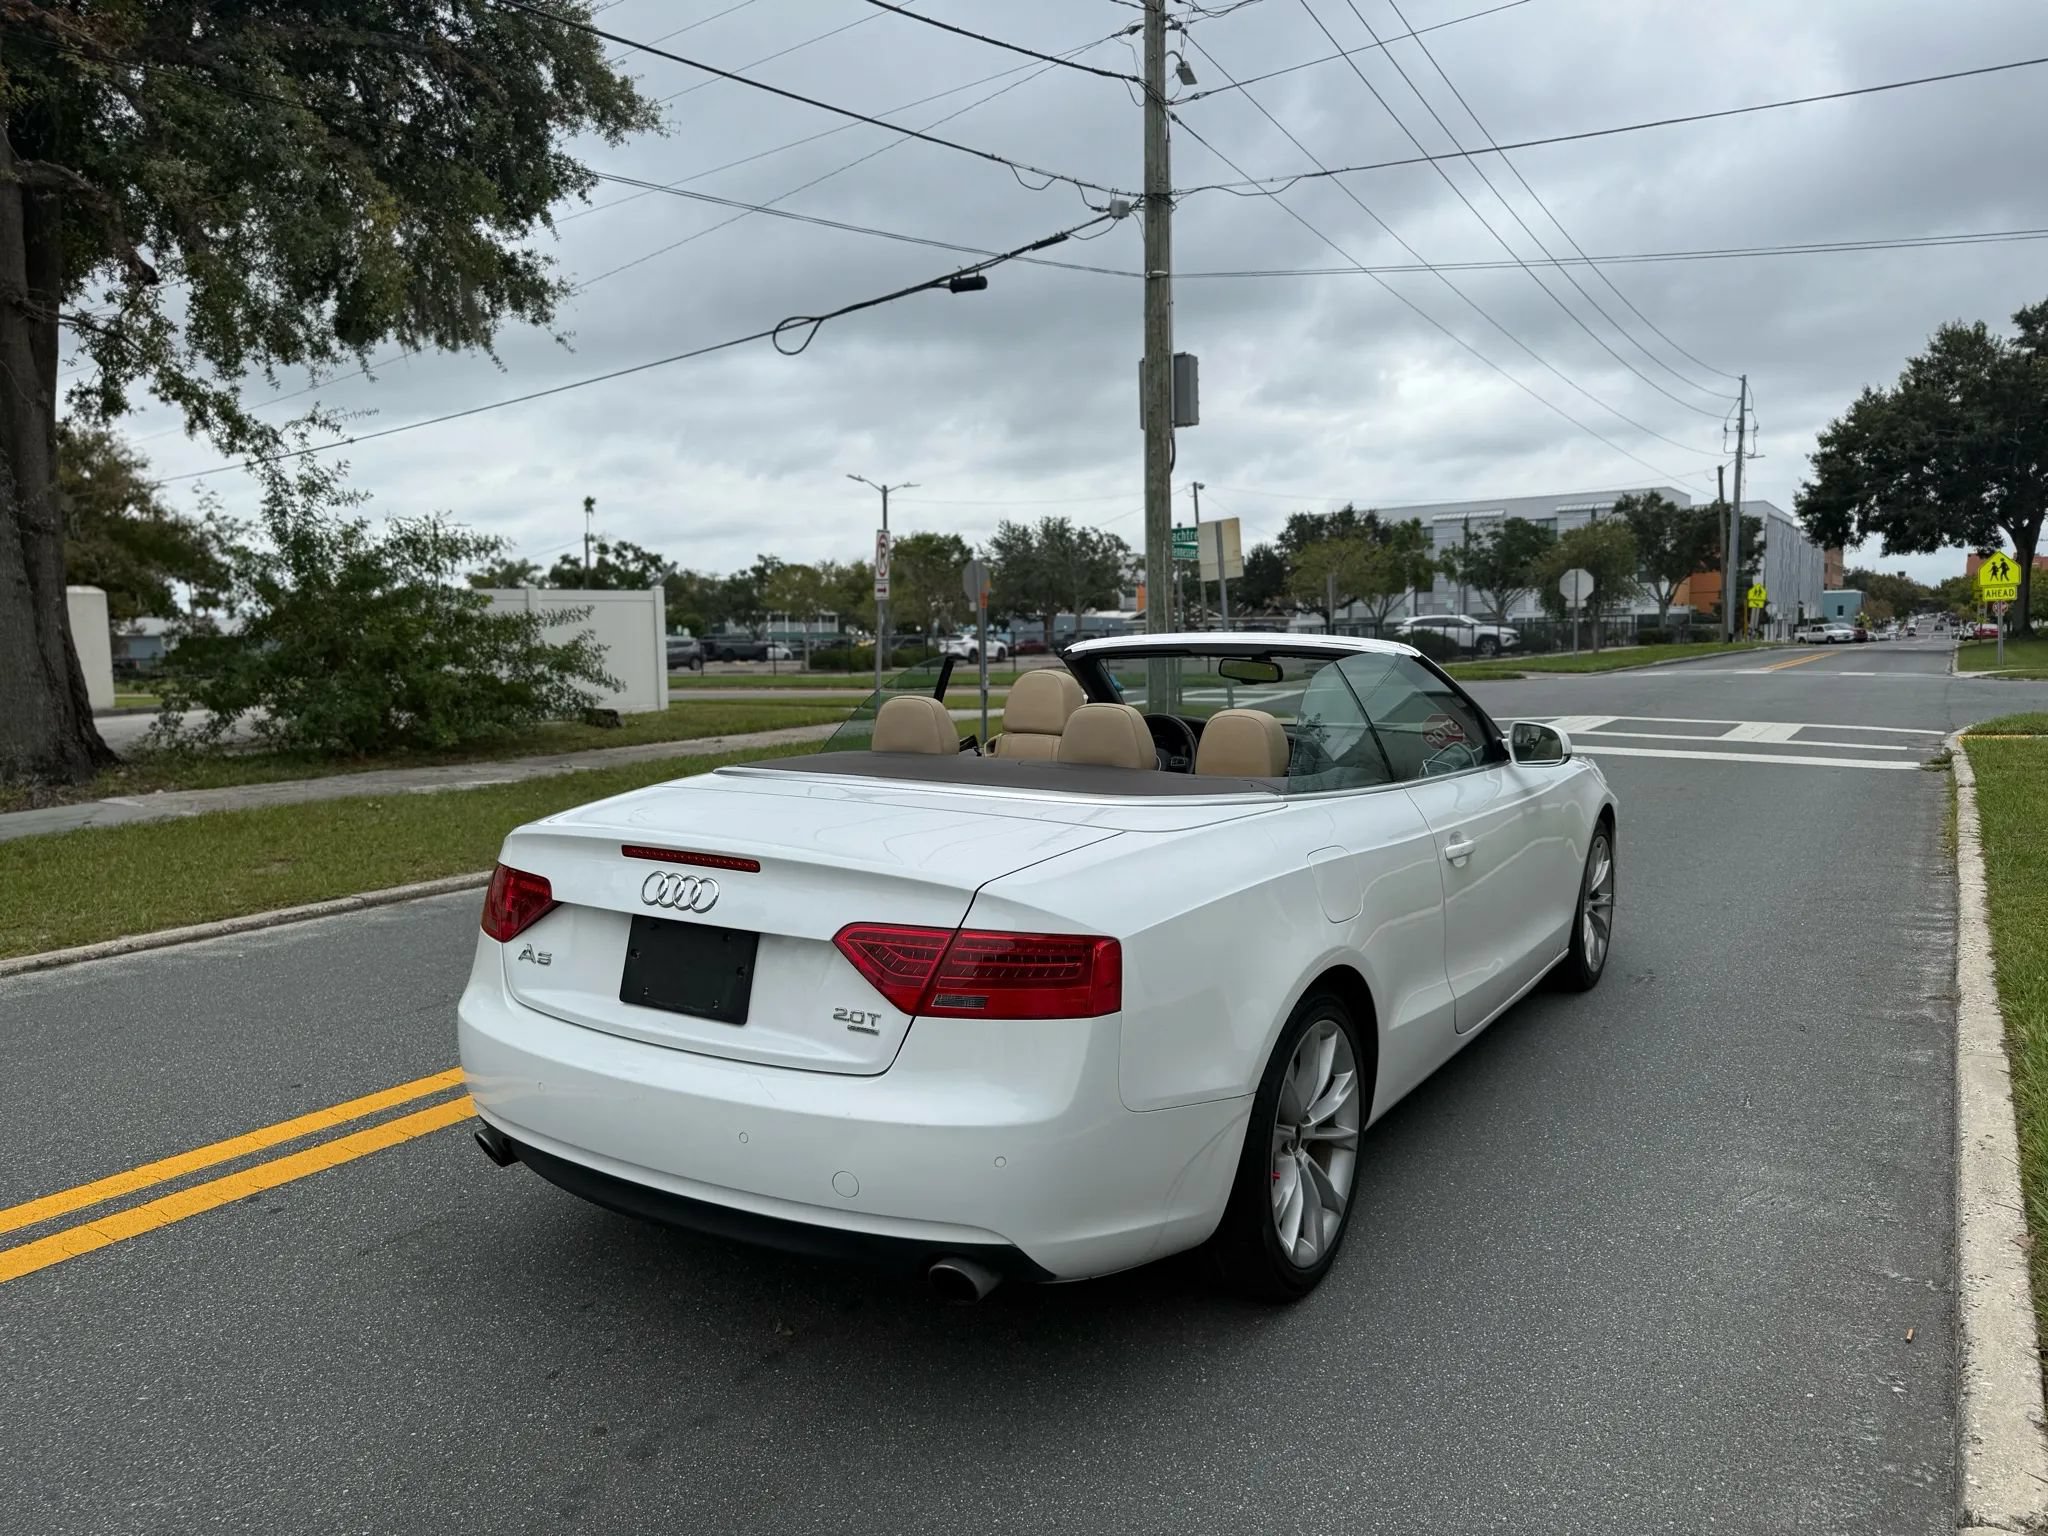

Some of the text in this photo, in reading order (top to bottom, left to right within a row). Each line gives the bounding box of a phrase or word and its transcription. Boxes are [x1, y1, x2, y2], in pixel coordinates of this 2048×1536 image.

[1172, 529, 1198, 542] achtre
[1985, 588, 2015, 598] AHEAD
[518, 943, 552, 966] A5
